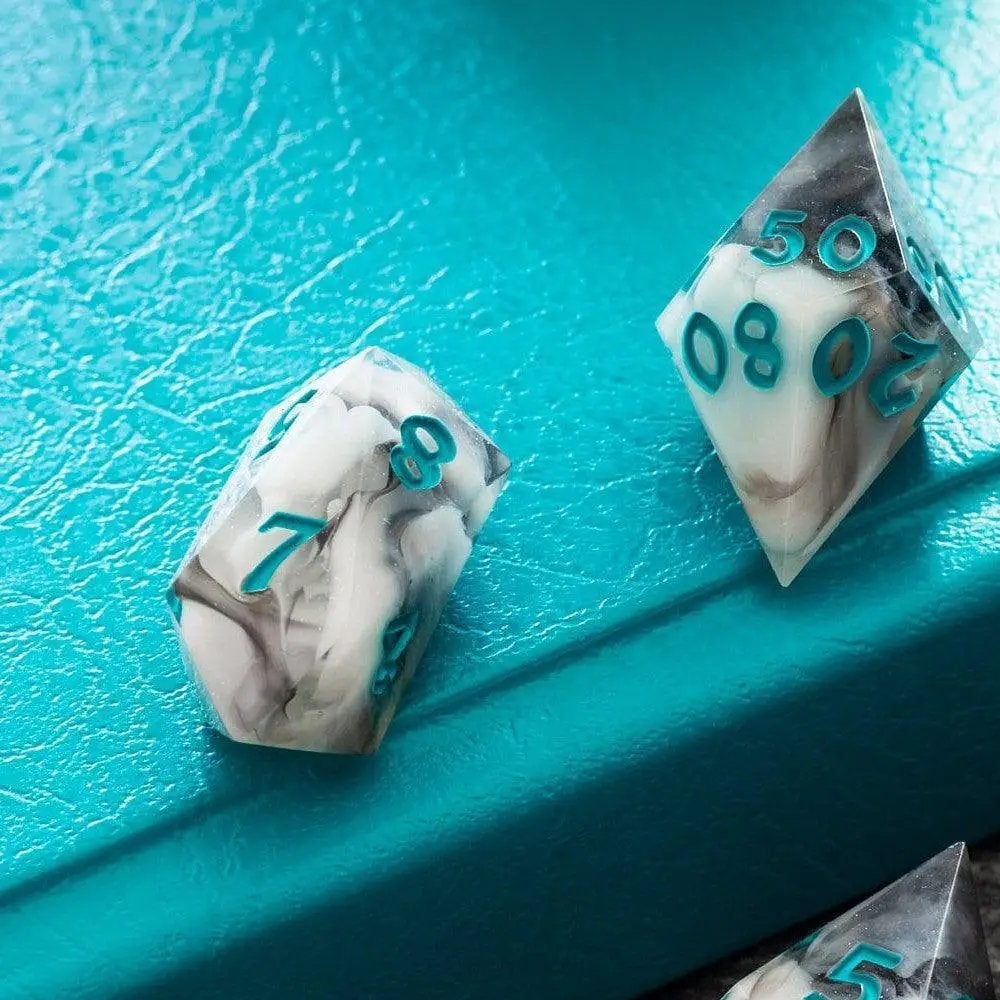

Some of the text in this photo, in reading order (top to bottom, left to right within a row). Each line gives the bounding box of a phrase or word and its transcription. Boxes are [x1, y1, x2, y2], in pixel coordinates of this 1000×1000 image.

[750, 209, 878, 272] 50
[390, 415, 457, 490] 8
[240, 511, 328, 593] 7
